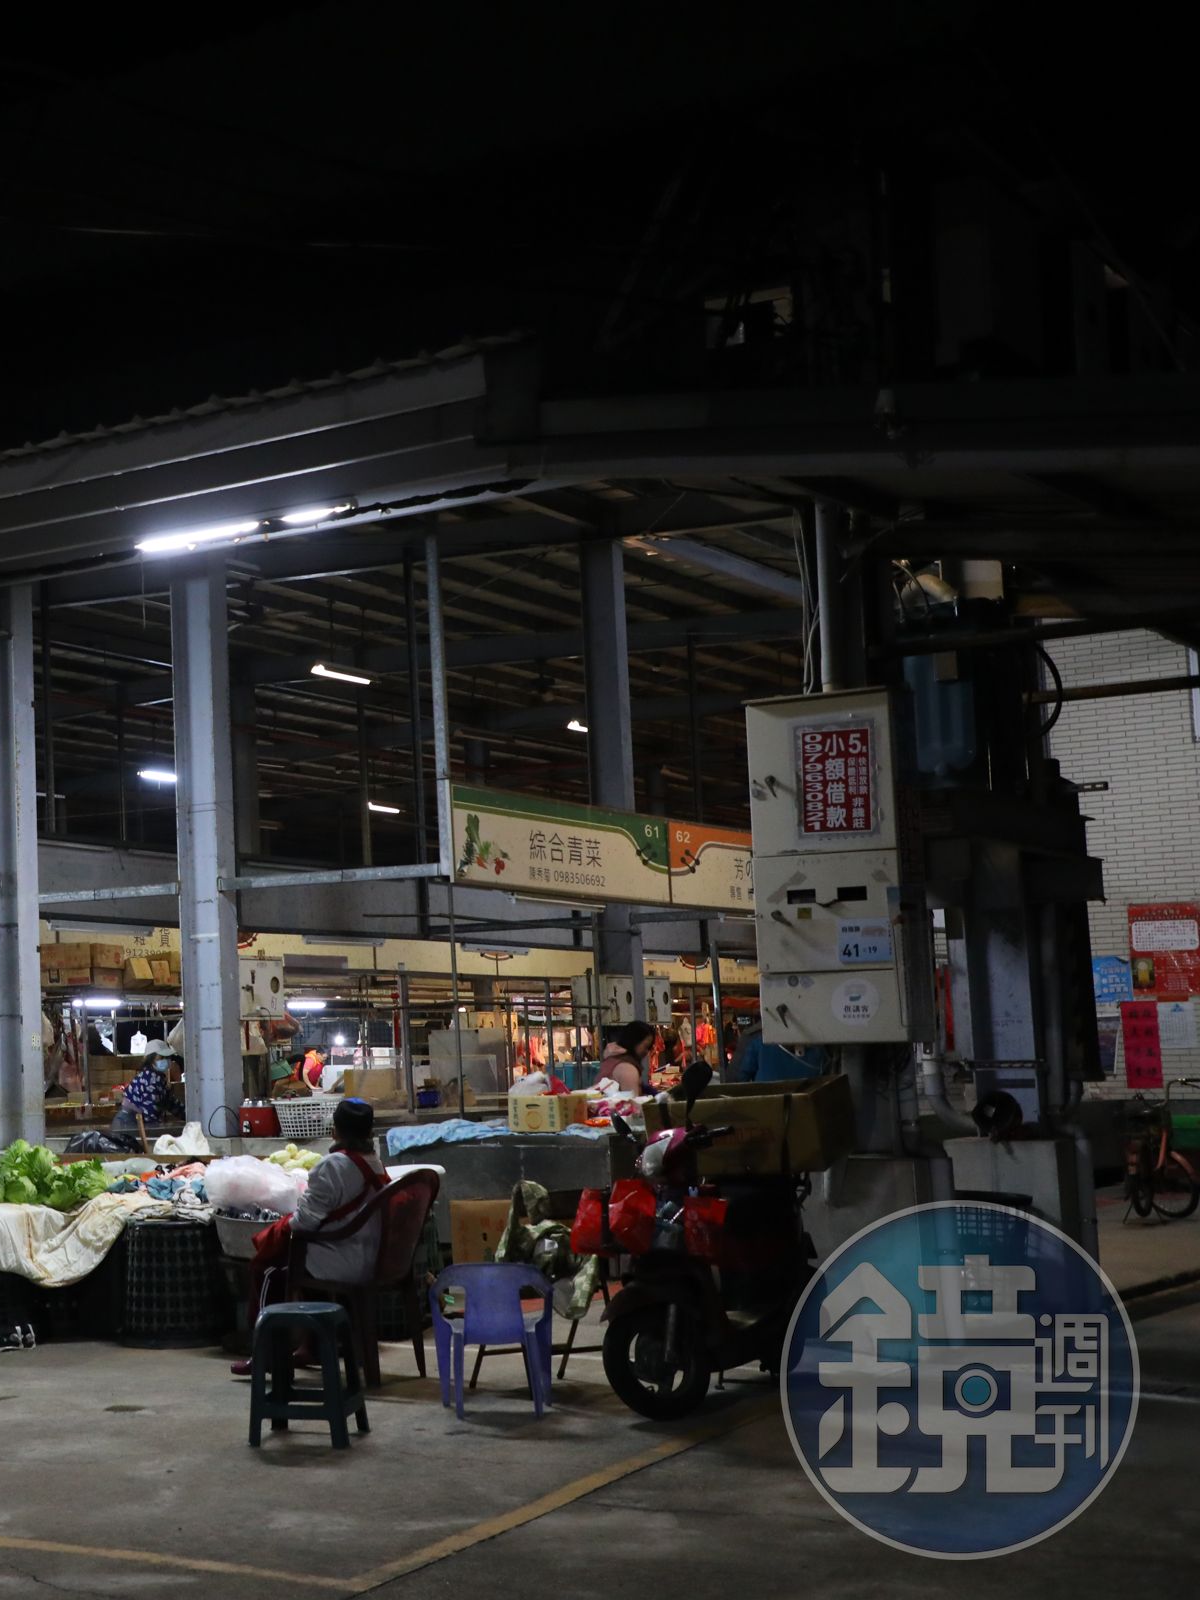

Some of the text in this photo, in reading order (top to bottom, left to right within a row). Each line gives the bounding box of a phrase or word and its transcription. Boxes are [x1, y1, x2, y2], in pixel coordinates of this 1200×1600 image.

[803, 733, 825, 831] 0979630821
[824, 733, 847, 828] 小額借款
[644, 824, 660, 839] 61
[675, 830, 691, 844] 62
[528, 829, 603, 868] 綜合青菜
[553, 870, 606, 888] 0983506692
[842, 943, 860, 958] 41
